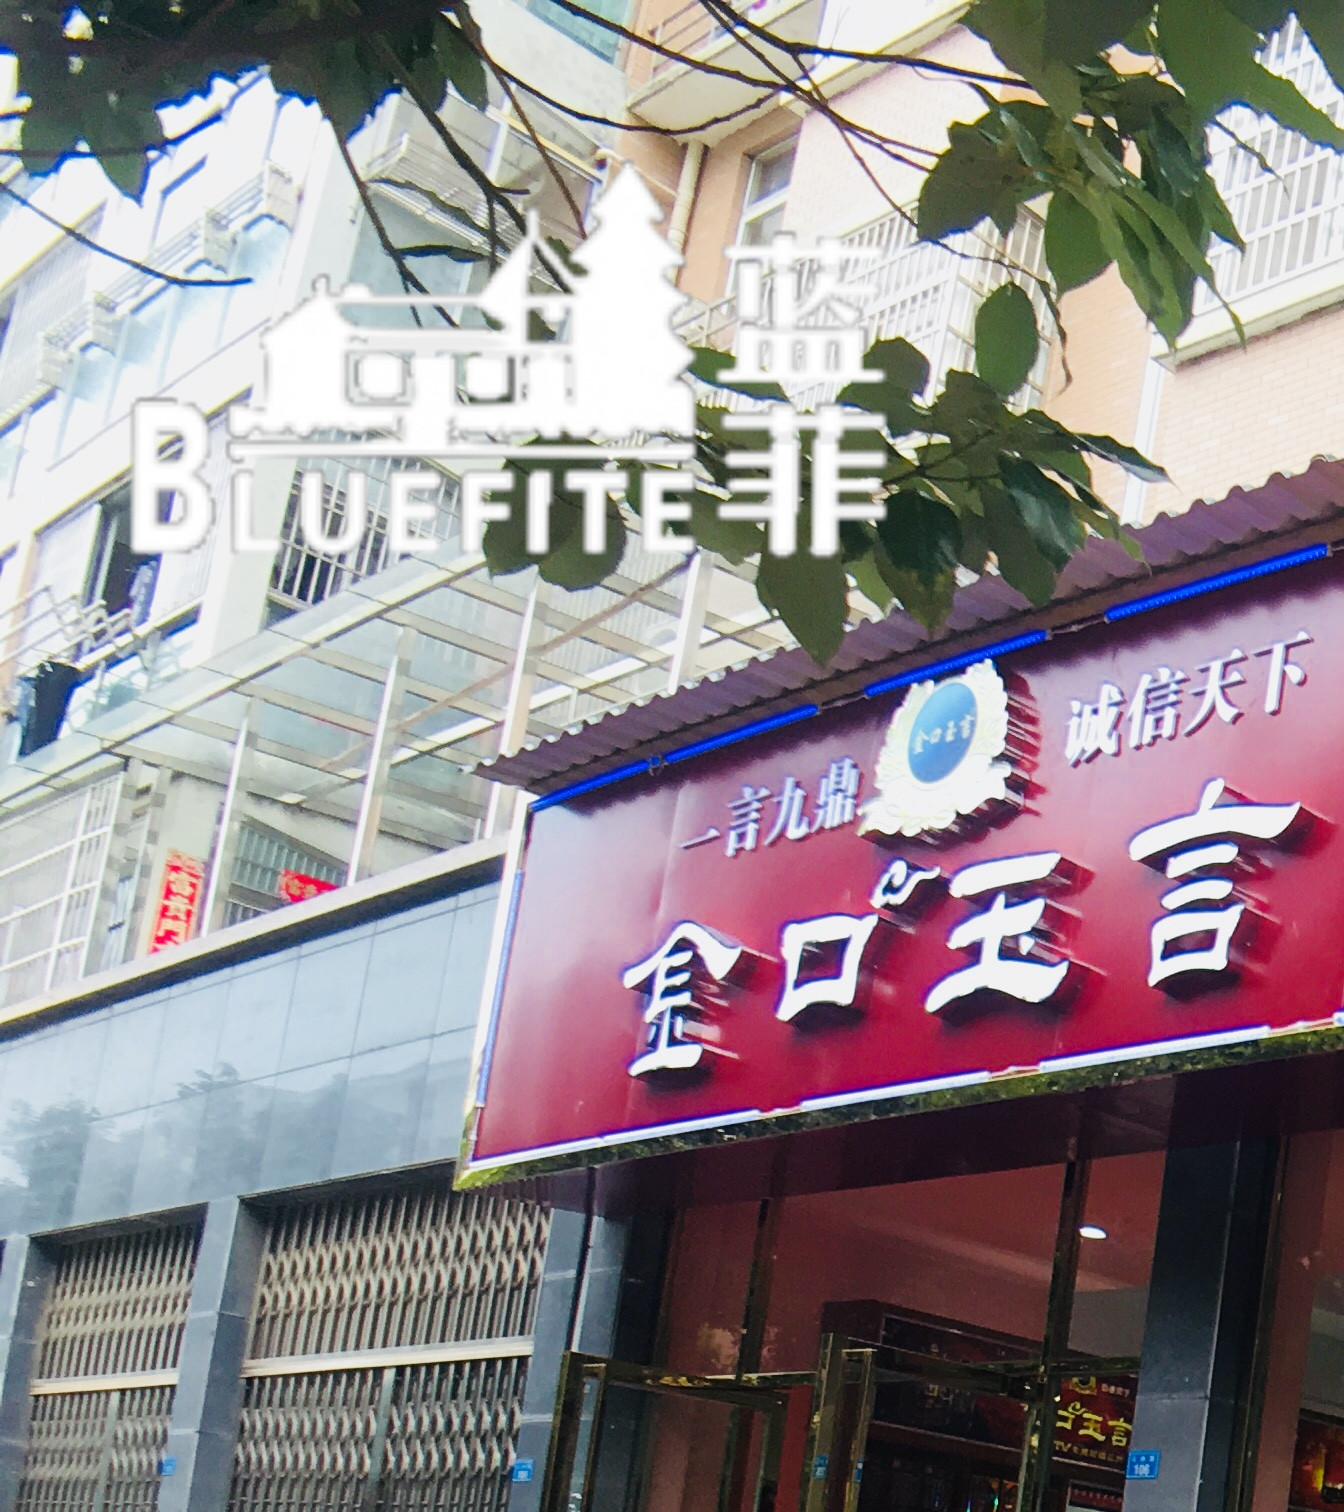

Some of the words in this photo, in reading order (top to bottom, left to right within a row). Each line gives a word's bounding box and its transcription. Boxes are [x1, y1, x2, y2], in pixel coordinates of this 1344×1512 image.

[1066, 630, 1313, 768] 诚信天下
[679, 757, 861, 858] 一言九鼎
[623, 776, 1301, 1079] 金口玉言
